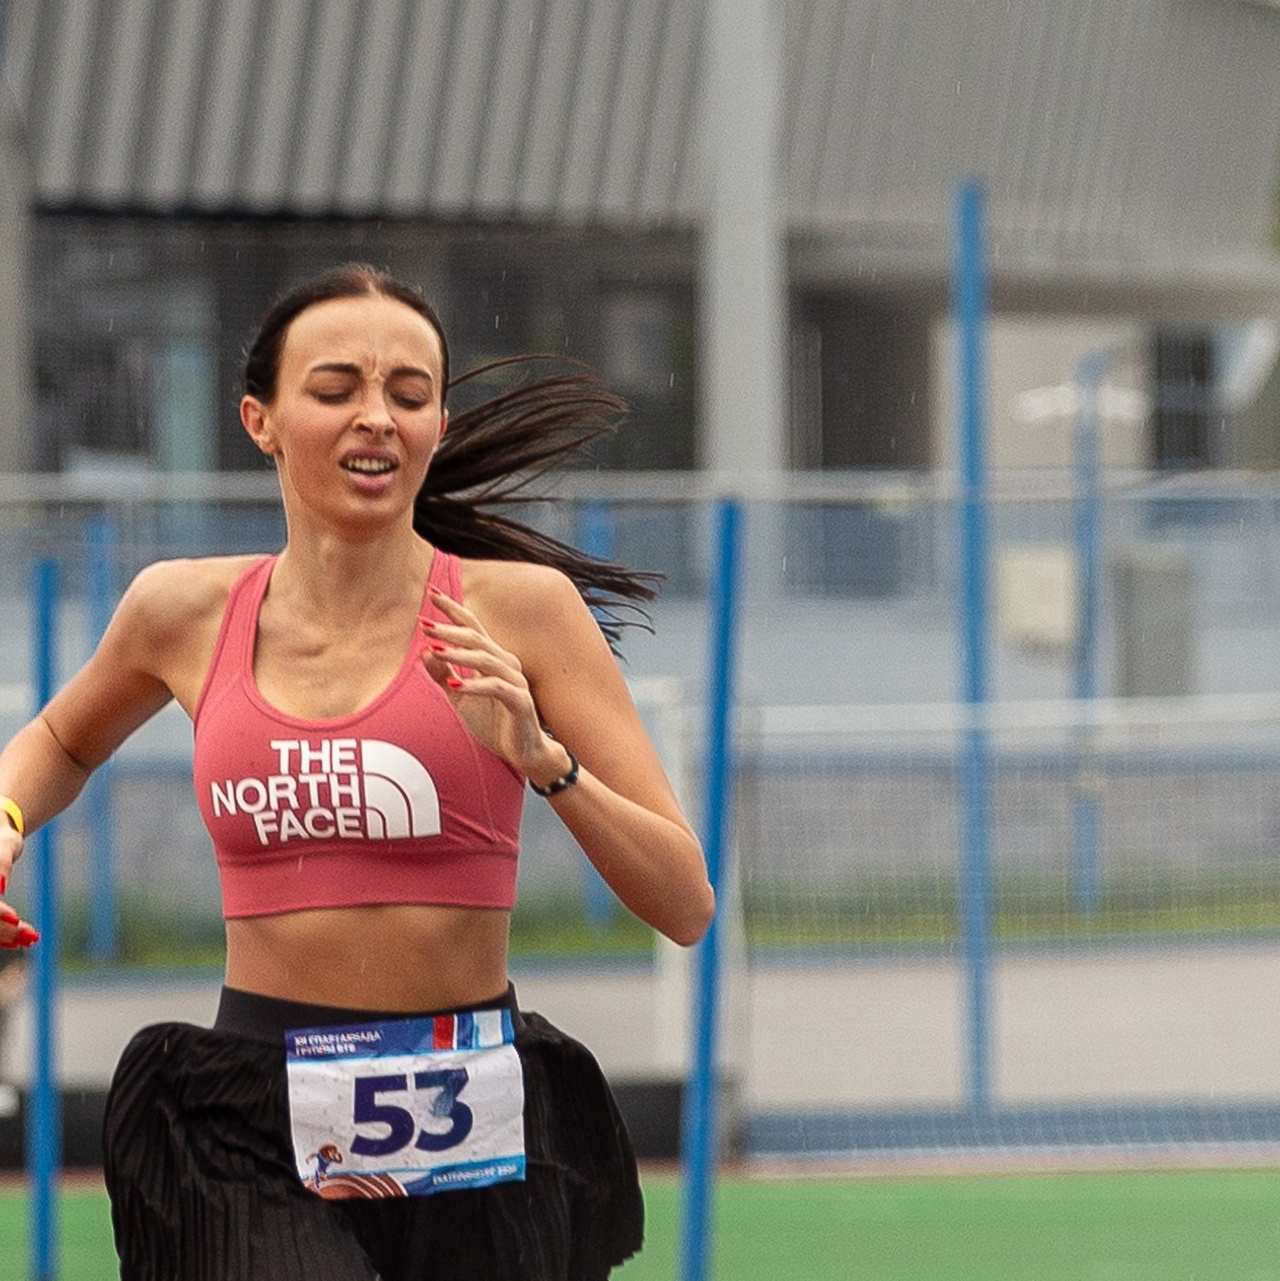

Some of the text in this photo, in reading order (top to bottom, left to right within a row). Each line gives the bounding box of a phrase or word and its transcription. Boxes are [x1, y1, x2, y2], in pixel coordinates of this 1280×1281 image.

[271, 738, 358, 773] THE
[210, 773, 361, 817] NORTH
[253, 807, 364, 846] FACE
[350, 1068, 473, 1157] 53
